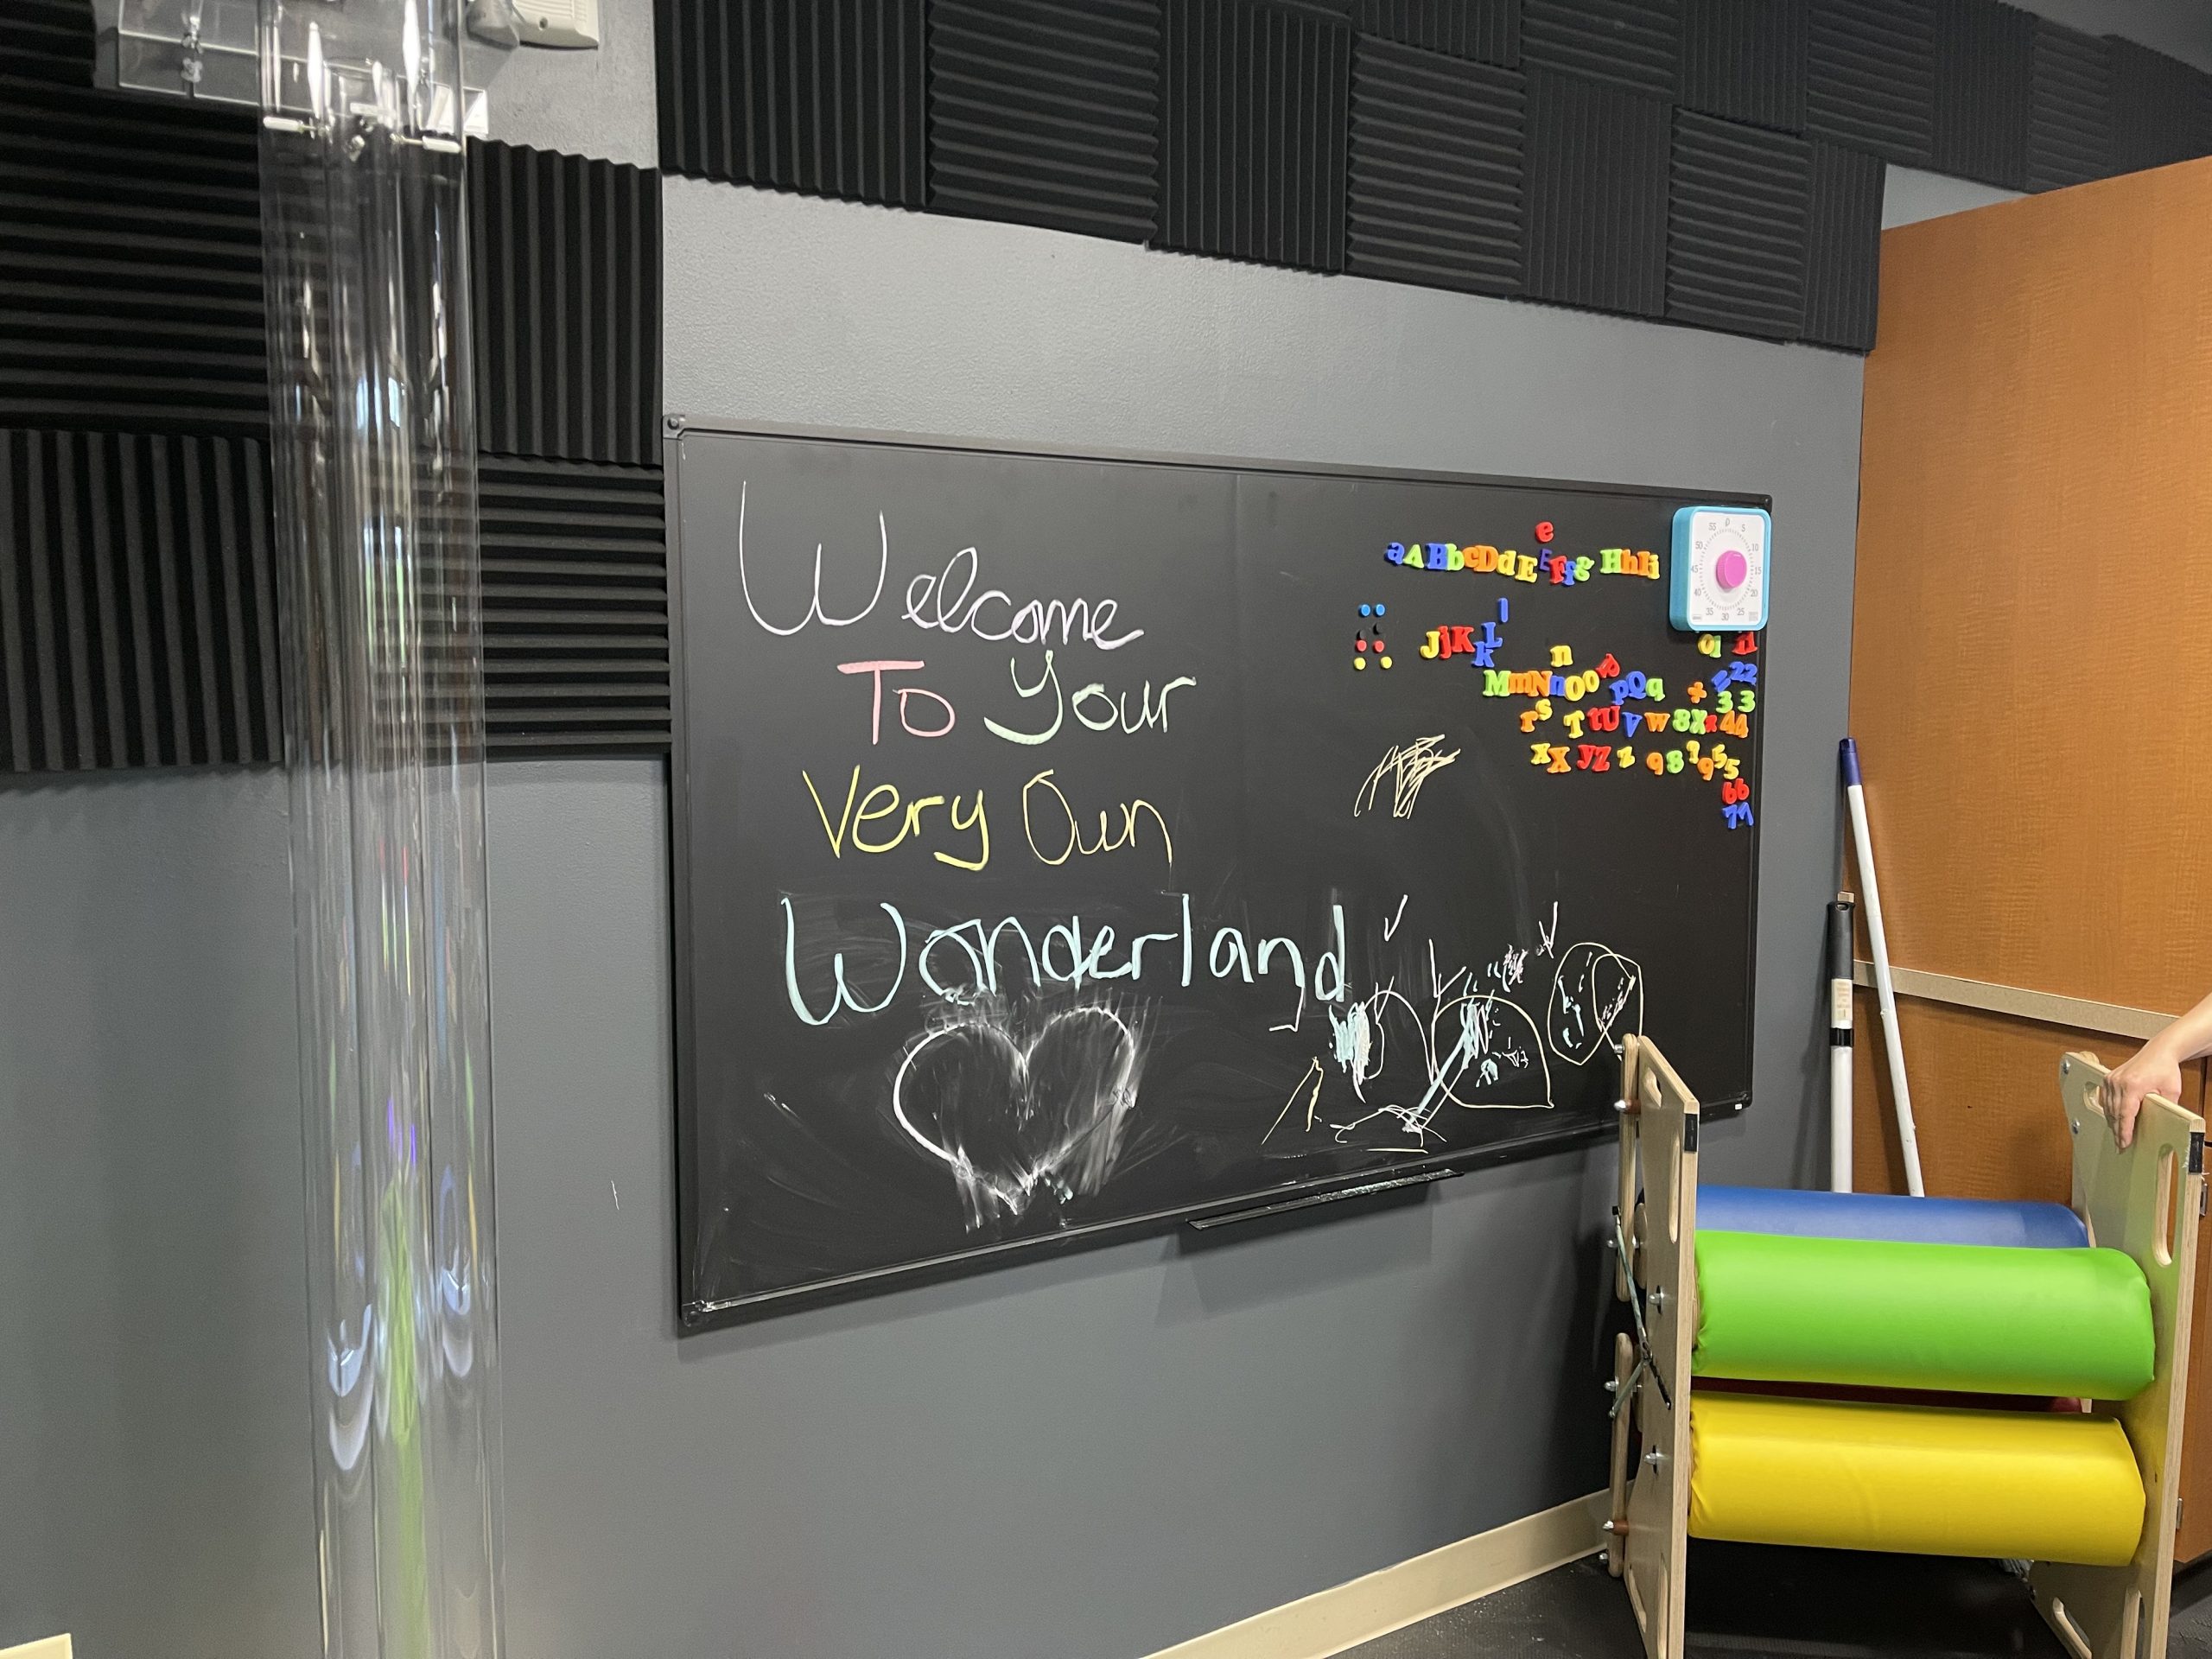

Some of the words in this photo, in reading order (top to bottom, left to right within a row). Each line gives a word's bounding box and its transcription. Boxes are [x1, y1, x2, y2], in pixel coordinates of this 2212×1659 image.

[1695, 541, 1703, 550] 50
[1751, 543, 1759, 551] 10
[739, 480, 1145, 650] Welcome
[1754, 566, 1762, 575] 15
[1750, 588, 1758, 597] 20
[1706, 607, 1713, 616] 35
[1737, 607, 1745, 616] 25
[1721, 613, 1729, 621] 30
[836, 659, 956, 746] To
[983, 649, 1197, 746] Your
[802, 764, 988, 871] Very
[1022, 769, 1173, 866] Own
[780, 893, 1345, 1032] Wonderland
